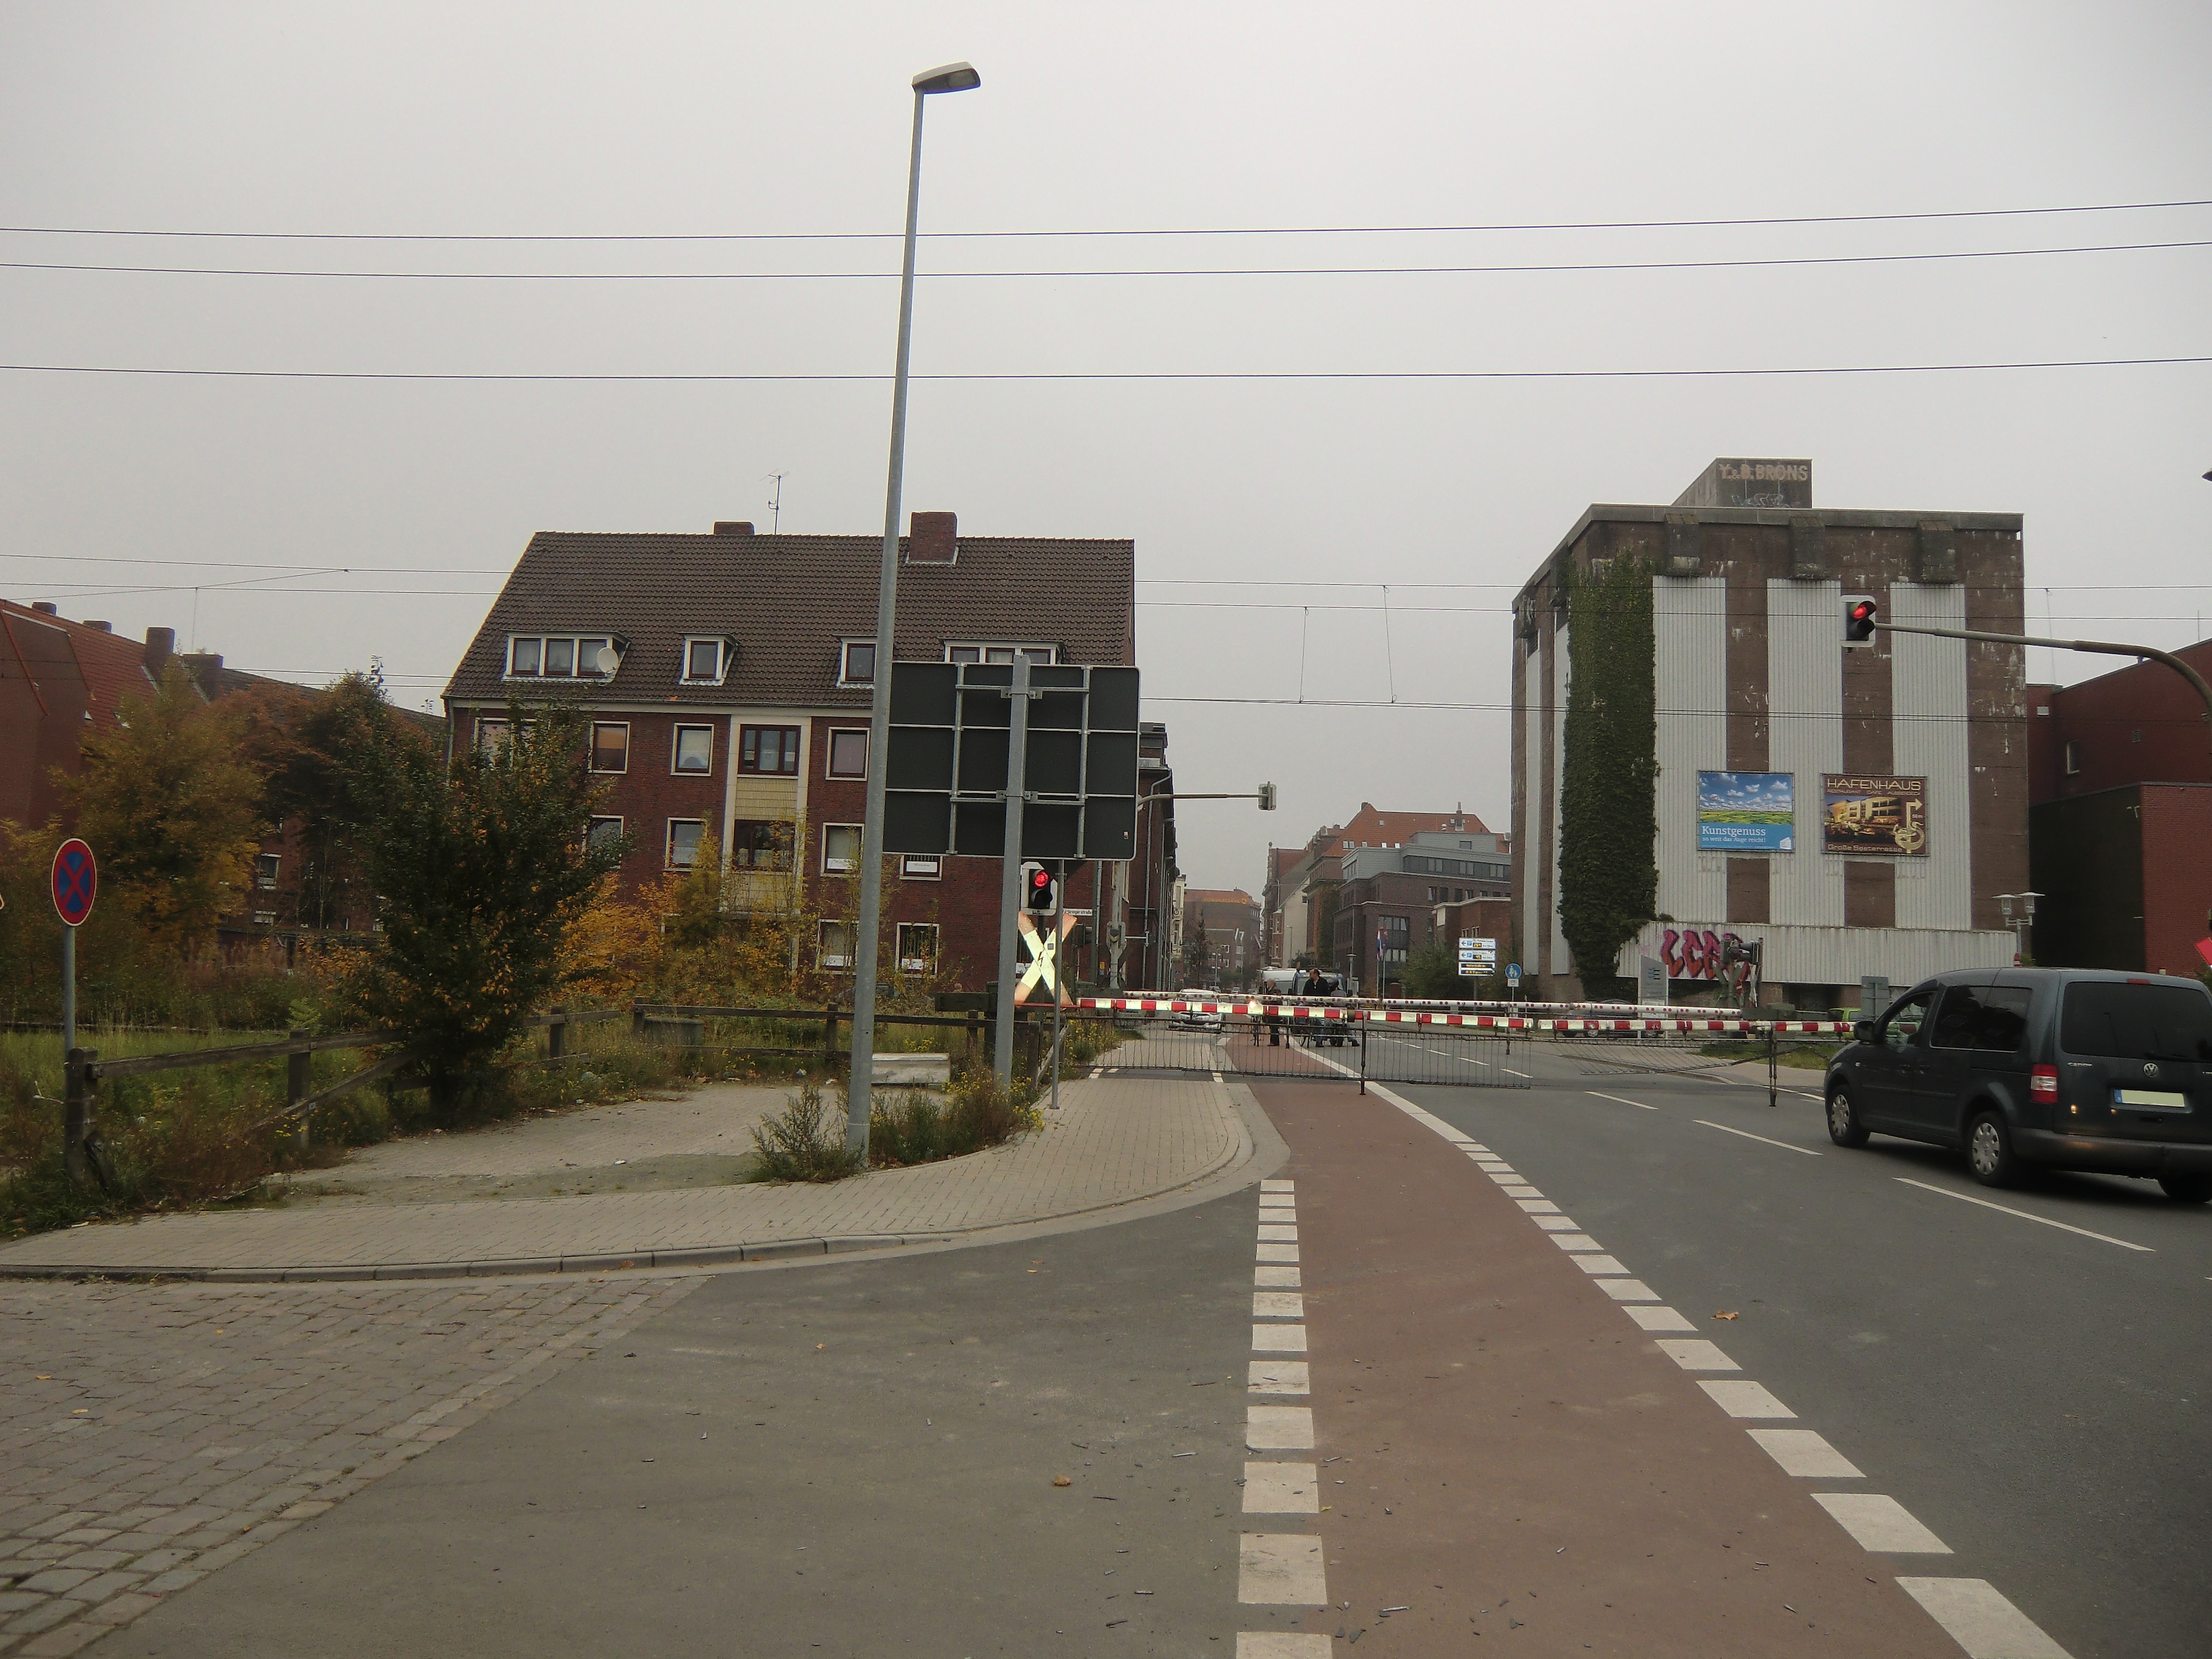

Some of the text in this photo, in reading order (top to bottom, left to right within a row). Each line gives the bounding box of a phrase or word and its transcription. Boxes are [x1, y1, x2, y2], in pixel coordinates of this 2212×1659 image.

[1755, 465, 1807, 481] BRONS
[1827, 778, 1921, 791] HAFENHAUS
[1702, 825, 1766, 837] Kunstgenuss
